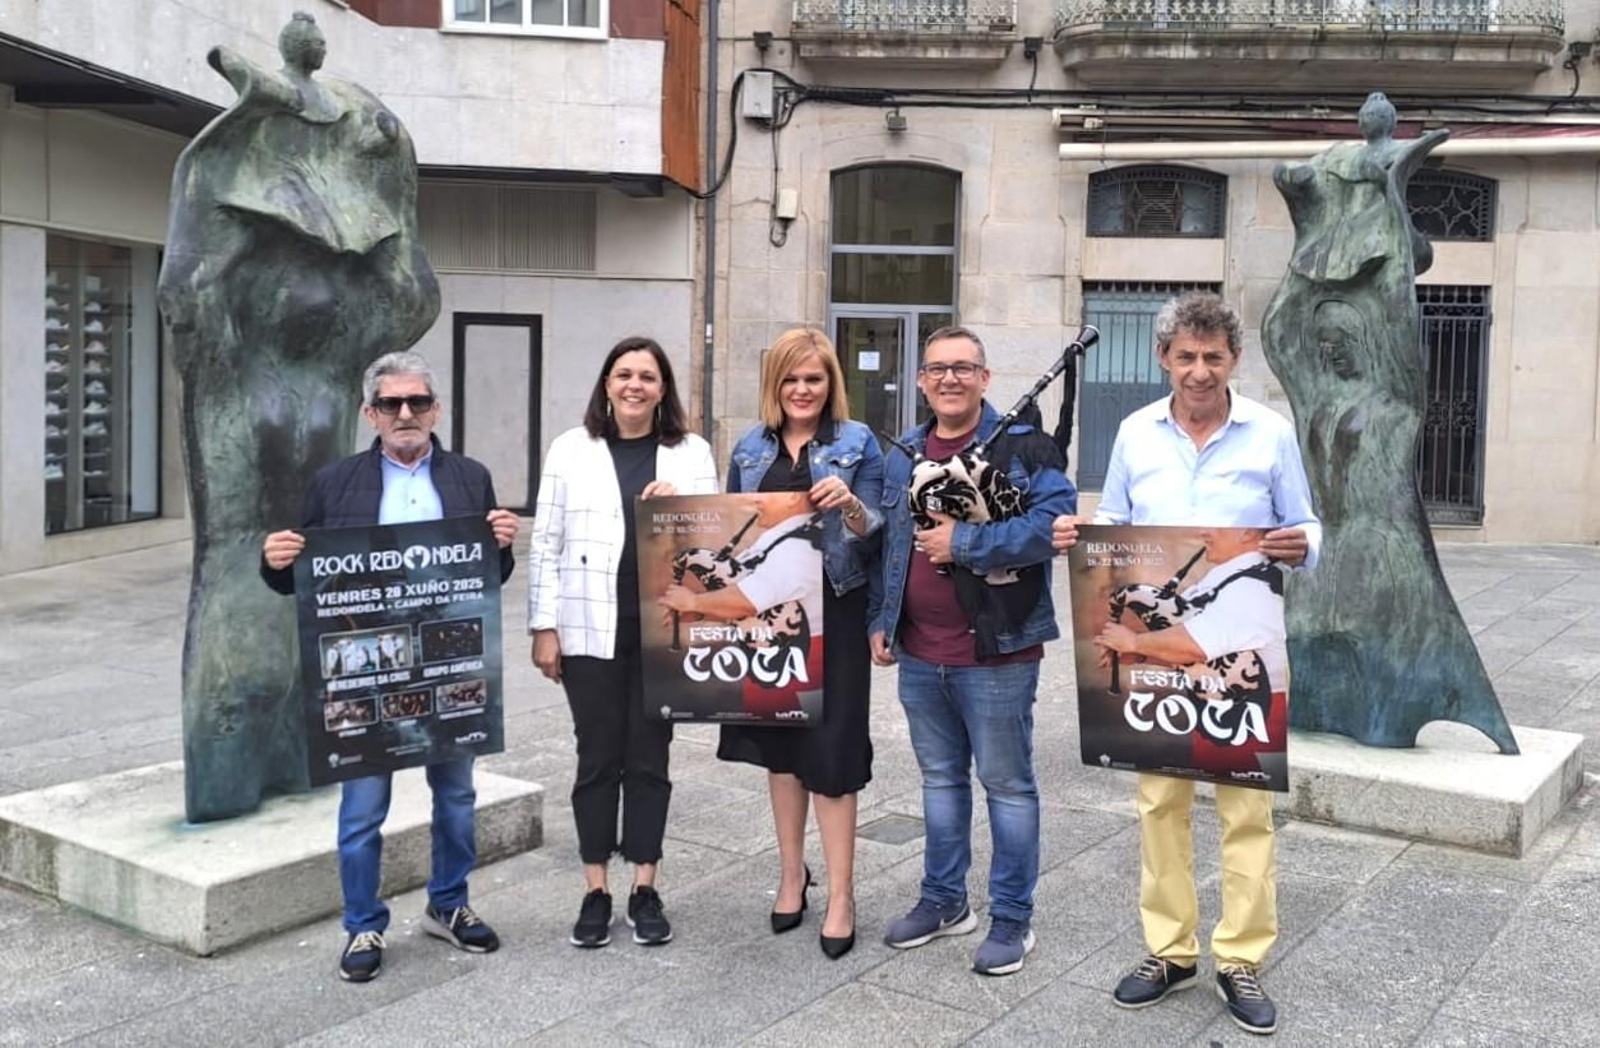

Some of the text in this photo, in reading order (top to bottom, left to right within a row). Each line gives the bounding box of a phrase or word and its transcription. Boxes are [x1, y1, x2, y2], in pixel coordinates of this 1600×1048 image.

[312, 542, 483, 578] ROCK REDONDELA
[1086, 541, 1164, 554] REDONDELA
[315, 587, 381, 606] VENRES
[405, 579, 450, 597] XUÑO
[452, 577, 484, 591] 2025
[316, 591, 484, 618] REDONDELA CAMPO DA FEIRA
[689, 626, 774, 642] FESTA DA
[683, 645, 809, 688] COCA
[1129, 669, 1227, 693] FESTA DA
[1123, 691, 1270, 746] COCA
